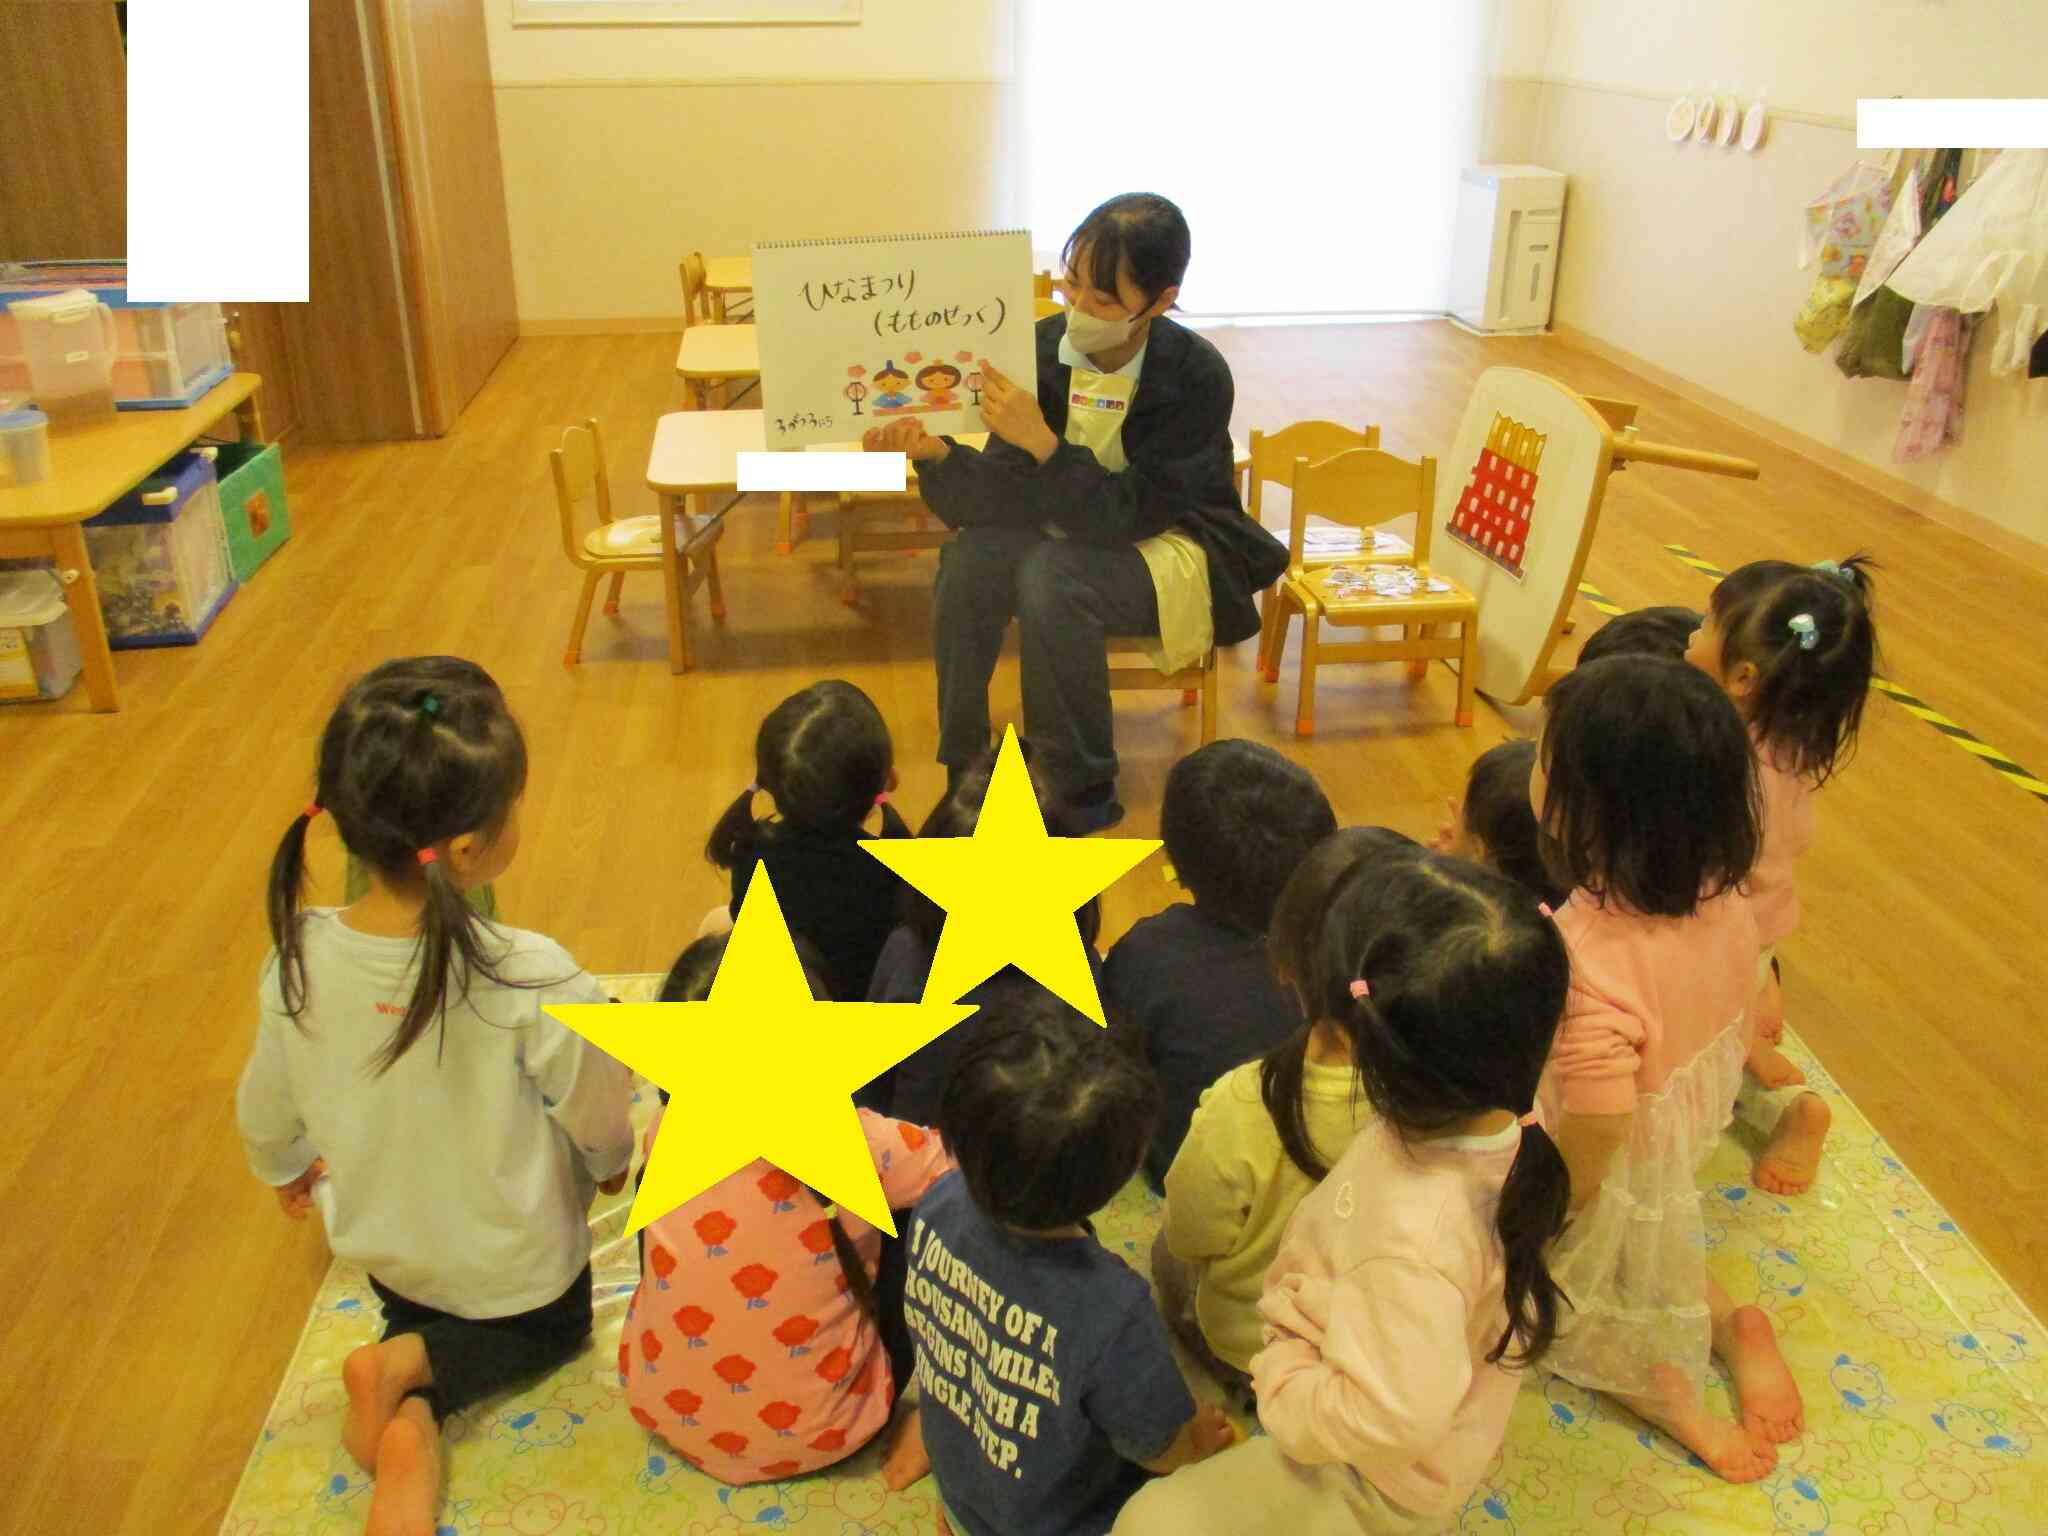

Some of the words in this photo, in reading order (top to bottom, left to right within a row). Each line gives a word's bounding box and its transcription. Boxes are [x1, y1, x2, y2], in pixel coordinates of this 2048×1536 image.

[799, 270, 915, 312] ひなまつり
[905, 1265, 989, 1358] HOUSAND
[1005, 1304, 1042, 1345] OF
[1041, 1324, 1058, 1358] A
[916, 1343, 972, 1427] INGLE
[1019, 1401, 1040, 1440] A
